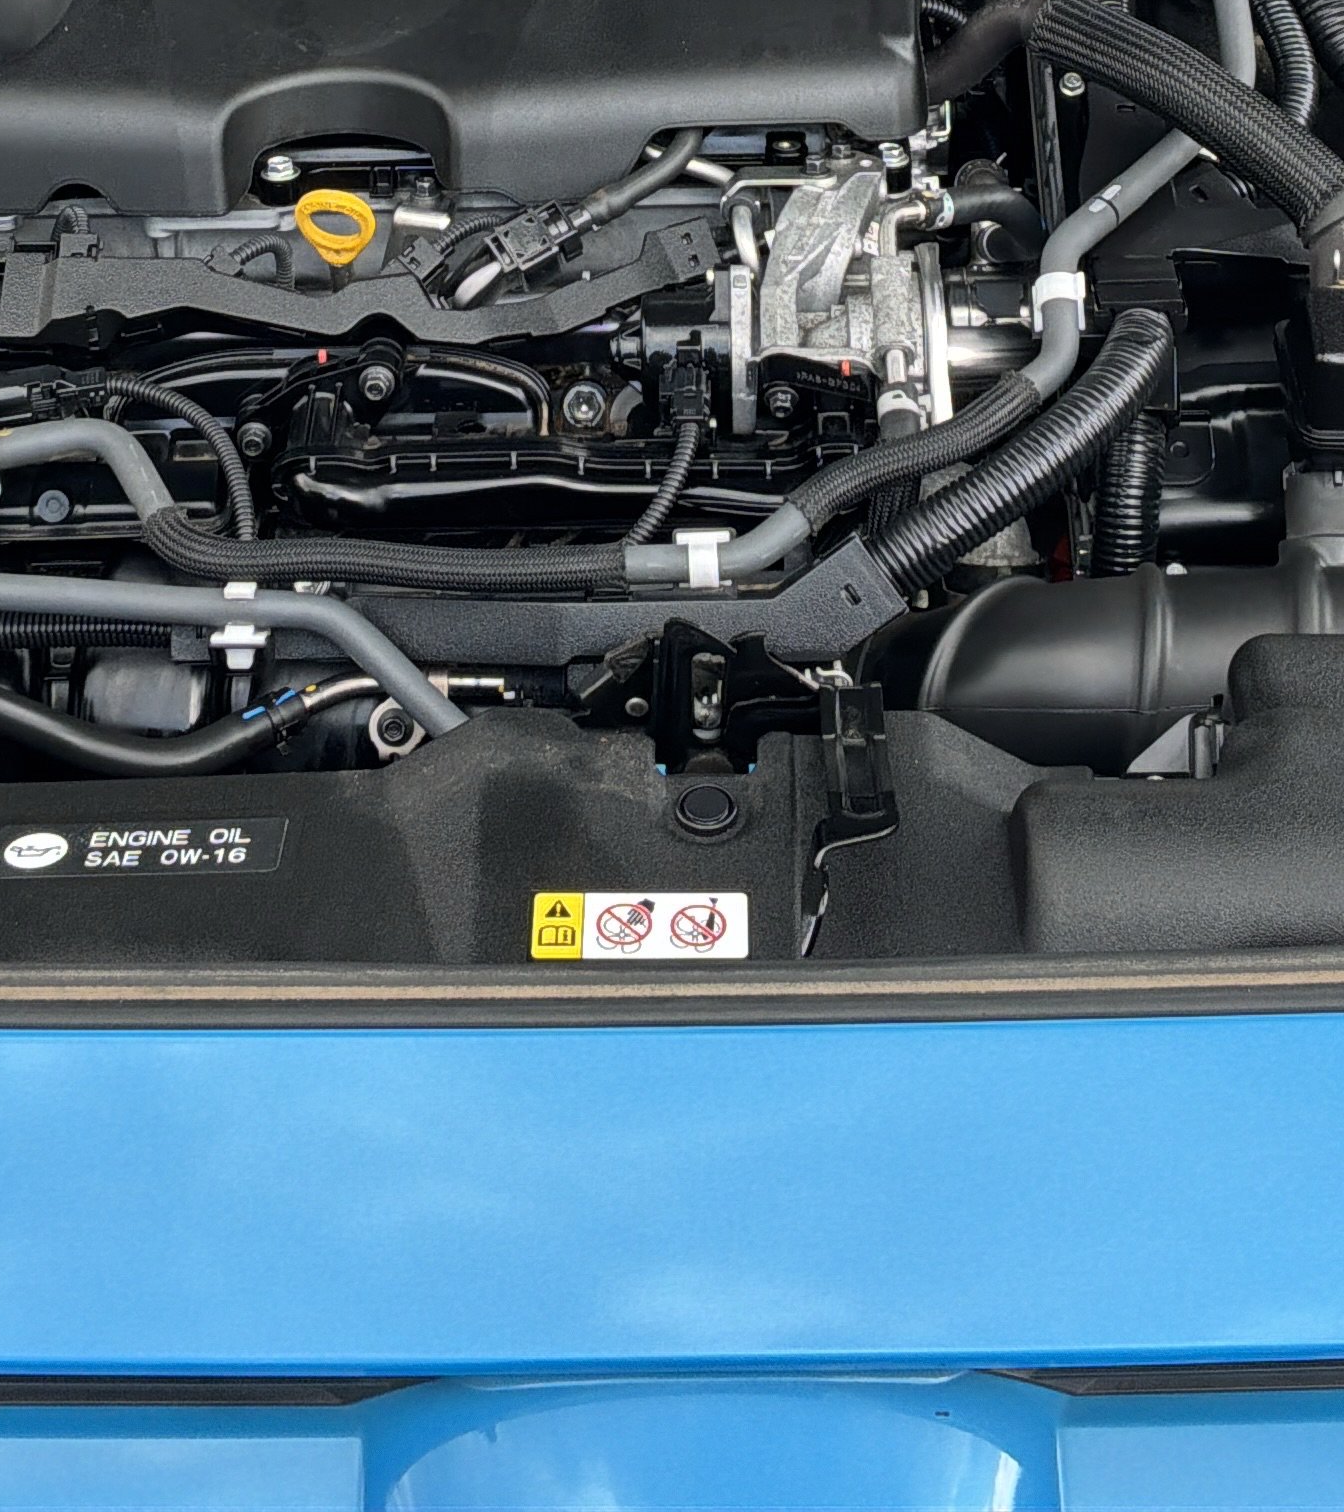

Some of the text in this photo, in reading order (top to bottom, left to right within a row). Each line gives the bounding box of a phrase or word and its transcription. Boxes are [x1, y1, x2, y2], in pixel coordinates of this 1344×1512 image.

[89, 828, 252, 849] ENGINE OIL
[84, 847, 247, 867] SAE 0W-16
